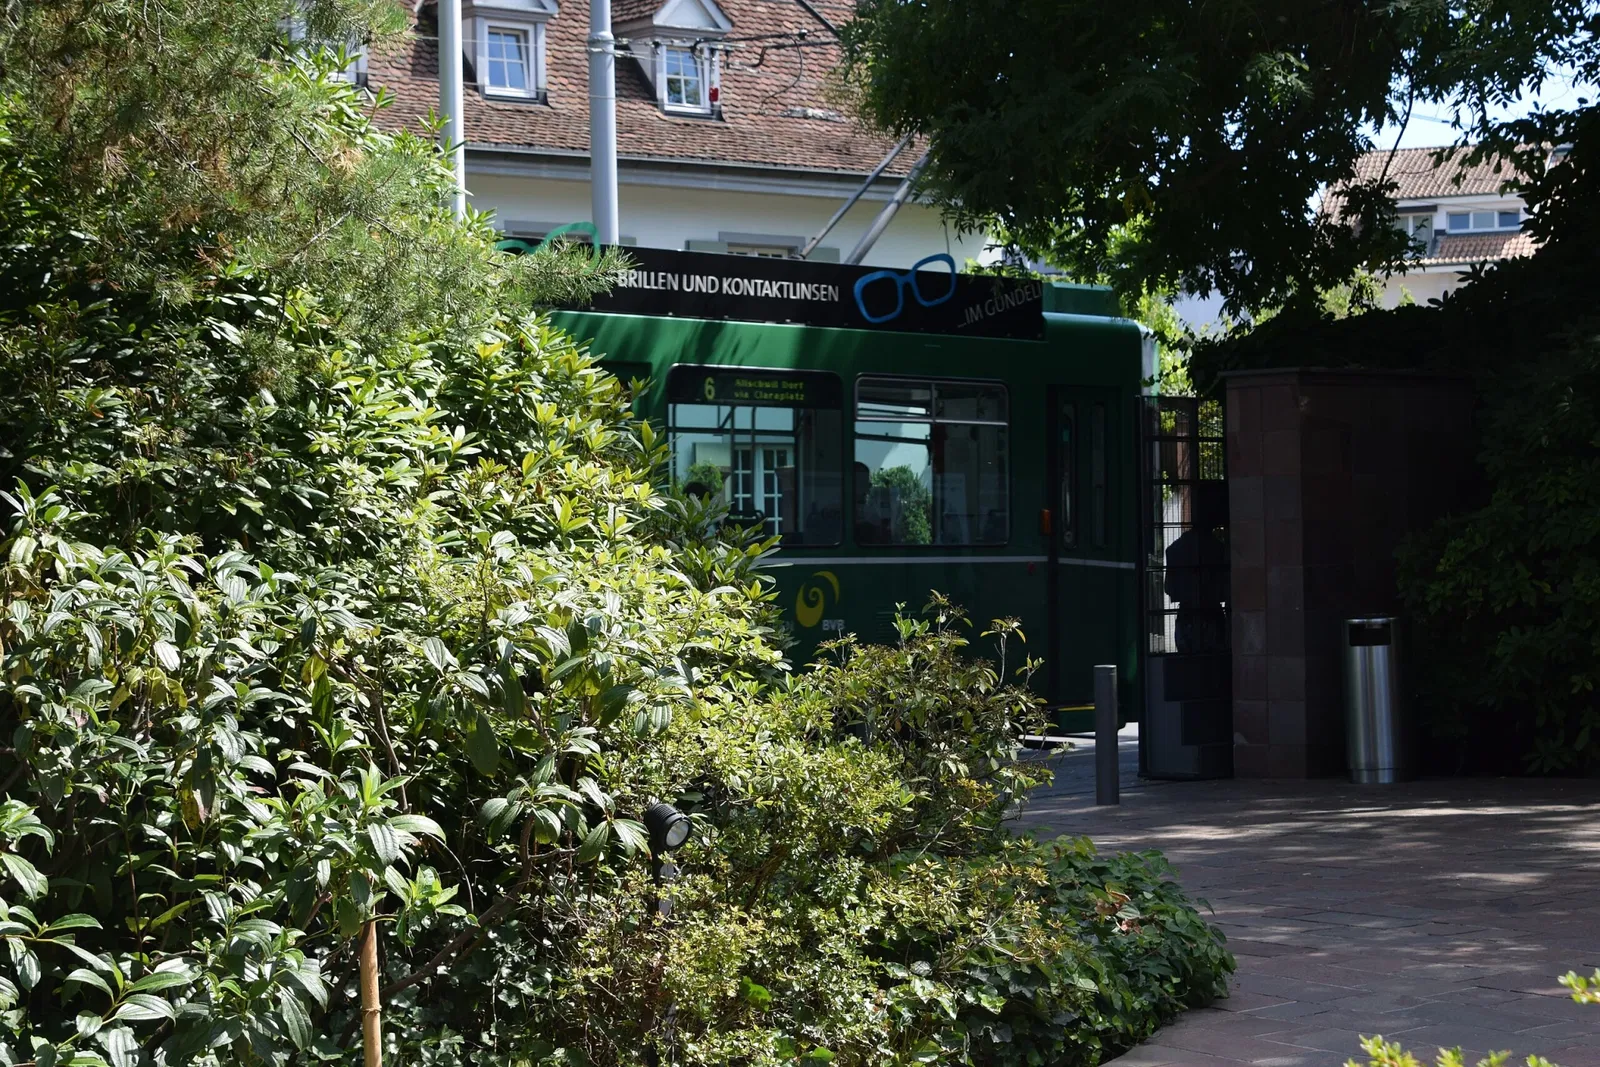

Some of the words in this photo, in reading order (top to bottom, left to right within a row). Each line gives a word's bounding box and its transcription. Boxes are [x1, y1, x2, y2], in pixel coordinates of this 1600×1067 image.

[617, 268, 679, 291] BRILLEN
[682, 274, 720, 294] UND
[722, 277, 839, 302] KONTAKTLINSEN
[704, 376, 715, 400] 6
[781, 380, 804, 390] Dorf
[734, 389, 749, 399] via
[754, 390, 805, 401] Claraplatz
[822, 619, 845, 631] BVB
